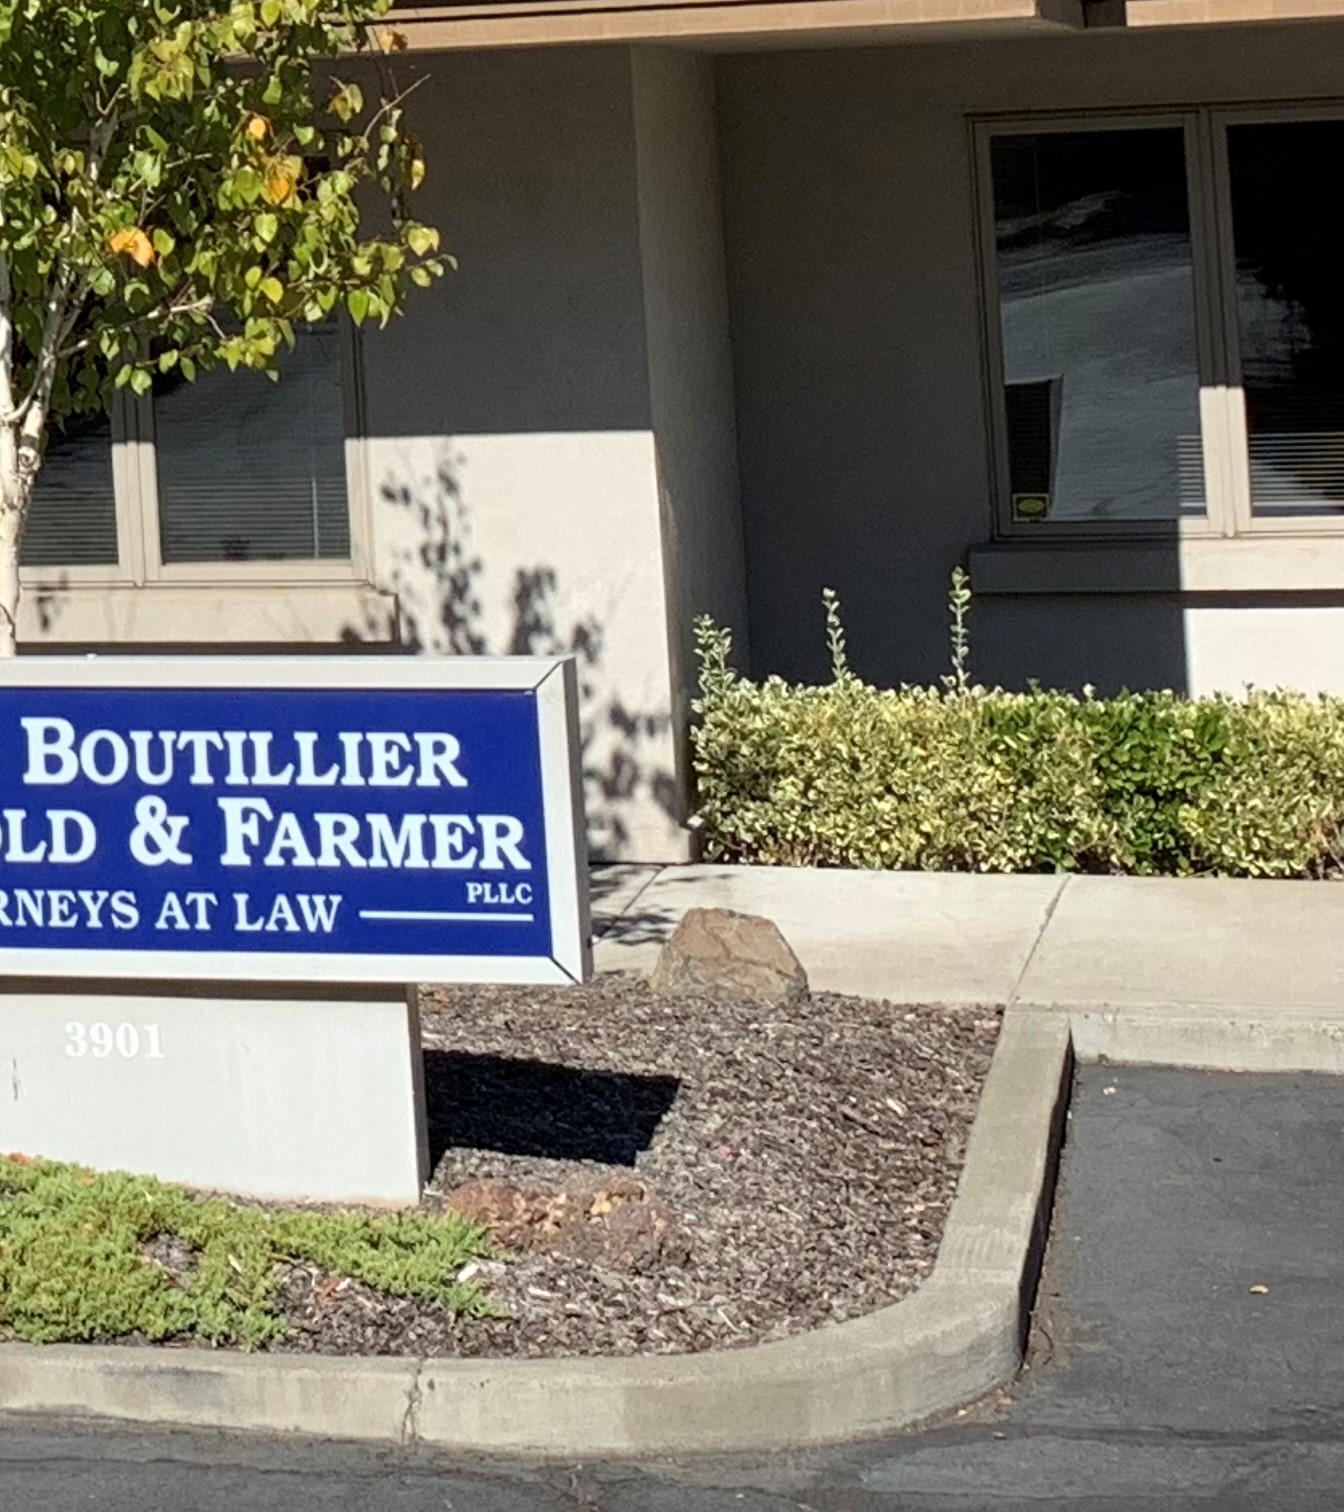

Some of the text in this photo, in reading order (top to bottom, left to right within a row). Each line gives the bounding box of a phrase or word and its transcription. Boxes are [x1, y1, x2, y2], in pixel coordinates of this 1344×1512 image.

[21, 718, 467, 786] BOUTILLIER
[130, 795, 192, 866] &
[218, 797, 531, 869] FARMER
[156, 892, 217, 930] AT
[234, 894, 342, 932] LAW
[467, 883, 532, 904] PLLC
[64, 1021, 165, 1058] 3901
